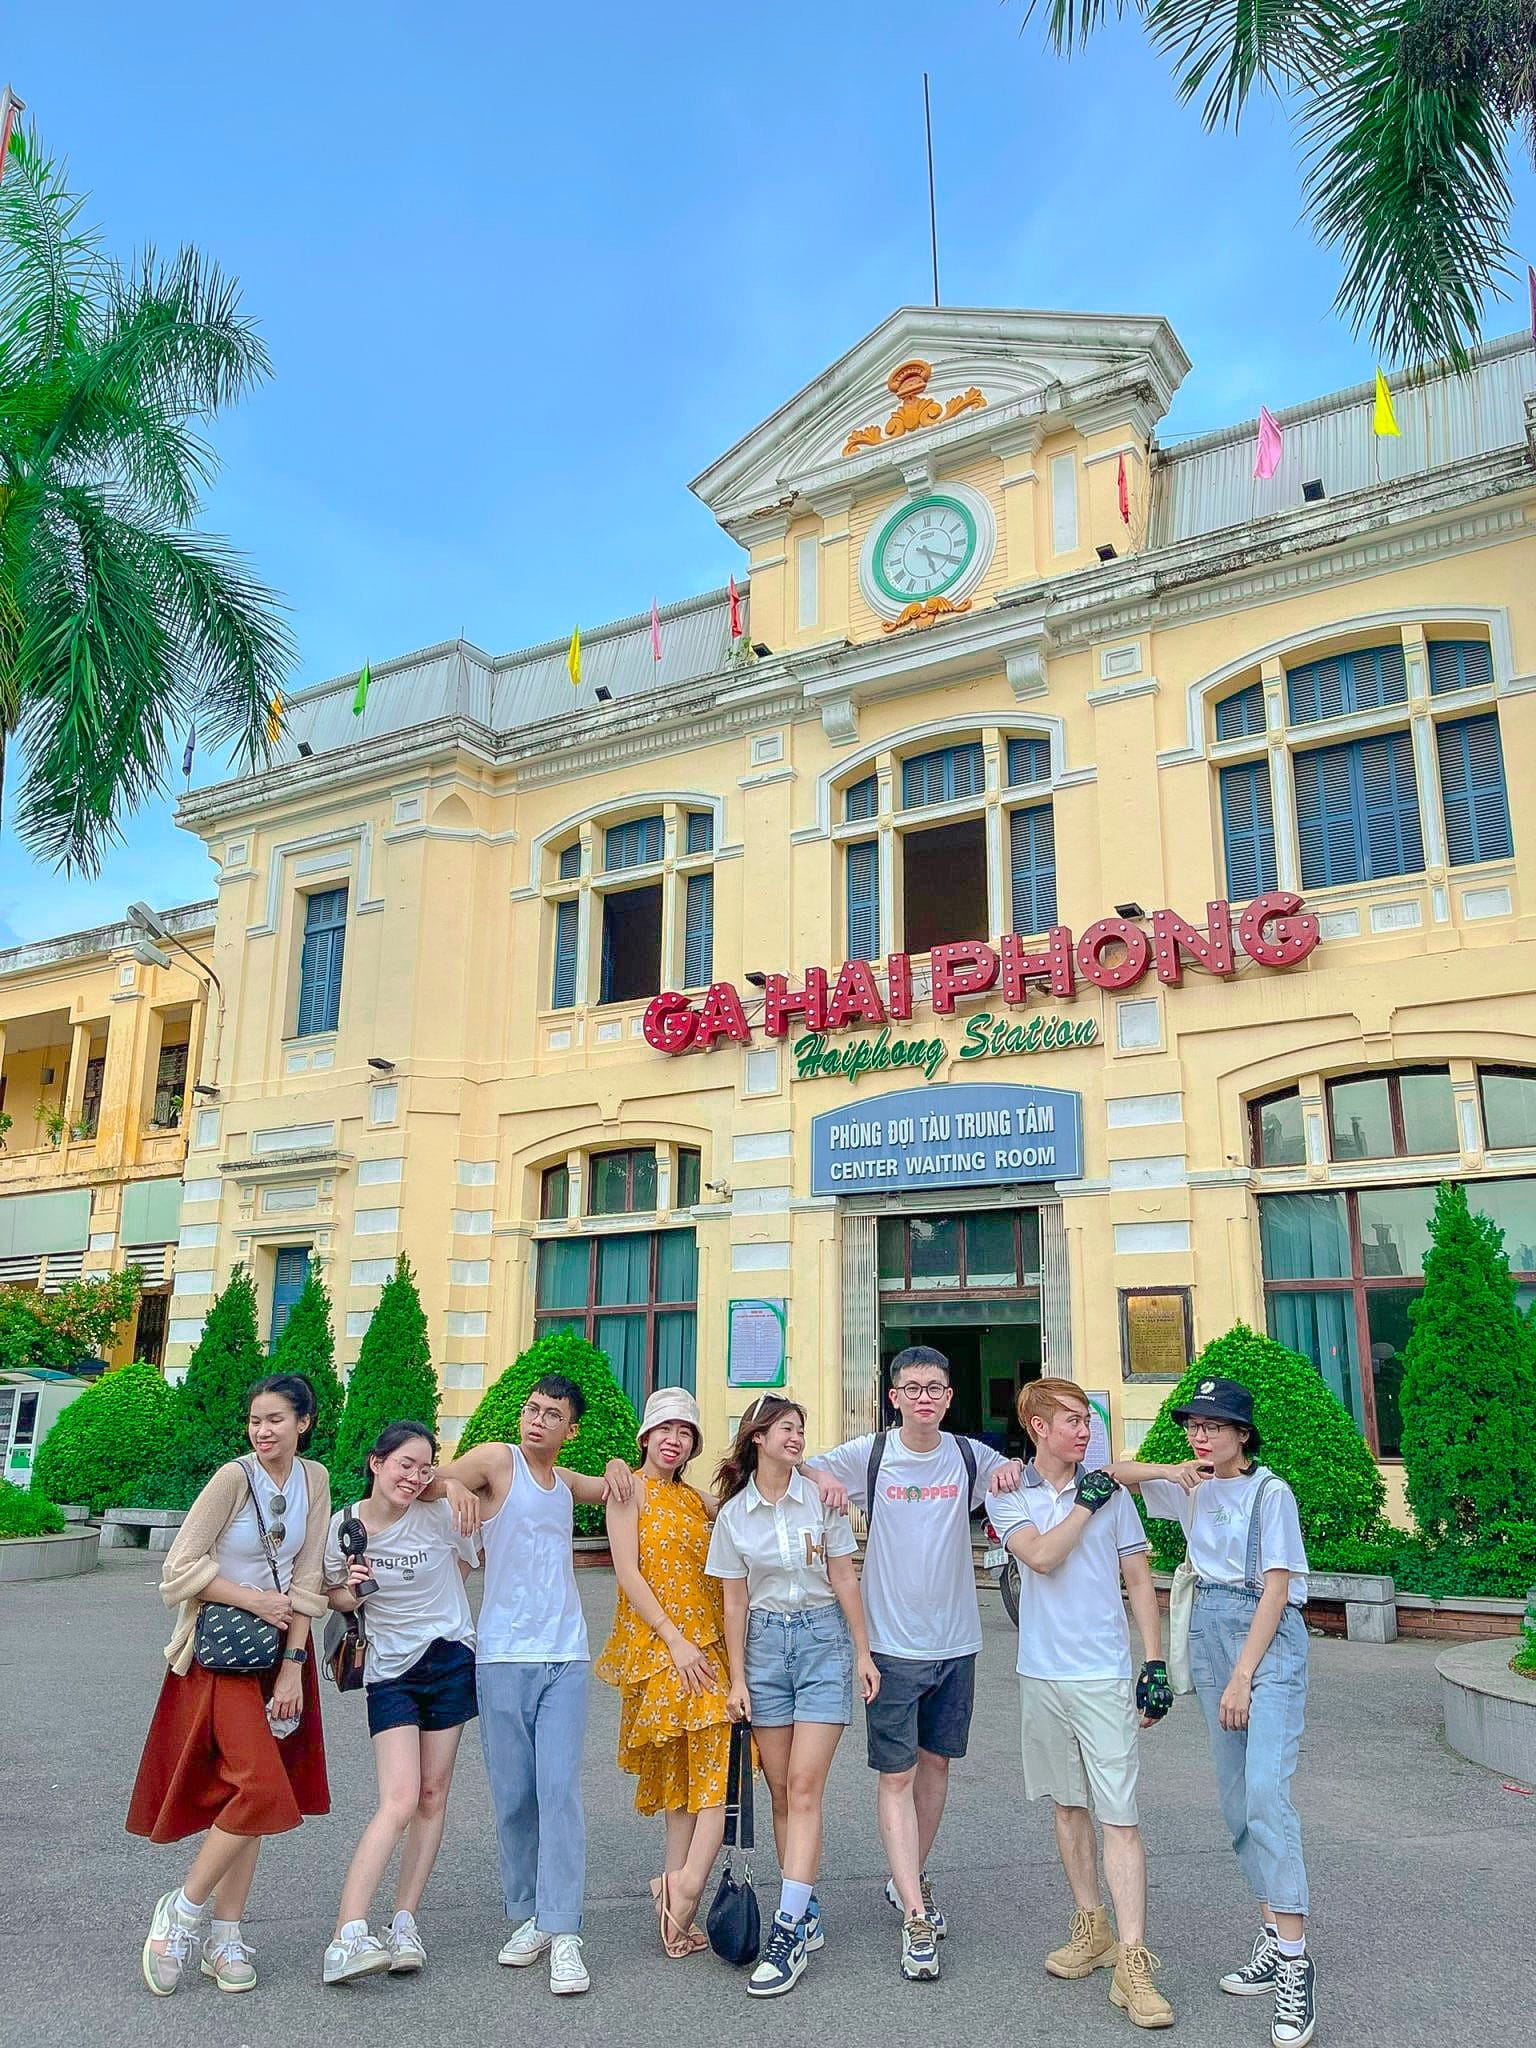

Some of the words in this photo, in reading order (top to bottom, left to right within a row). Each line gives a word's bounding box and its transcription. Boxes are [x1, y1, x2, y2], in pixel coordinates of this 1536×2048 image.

[643, 982, 749, 1053] GA
[765, 953, 912, 1037] HAI
[931, 892, 1320, 1014] PHONG
[793, 1027, 946, 1082] Haiphong
[960, 1012, 1097, 1061] Station
[830, 1118, 882, 1149] PHÒNG
[888, 1116, 914, 1149] ĐỢI
[920, 1110, 950, 1142] TÀU
[955, 1107, 1011, 1139] TRUNG
[1016, 1103, 1055, 1134] TÂM
[830, 1158, 898, 1180] CENTER
[905, 1151, 985, 1175] WAITING
[995, 1146, 1056, 1169] ROOM
[369, 1550, 428, 1570] ragraph
